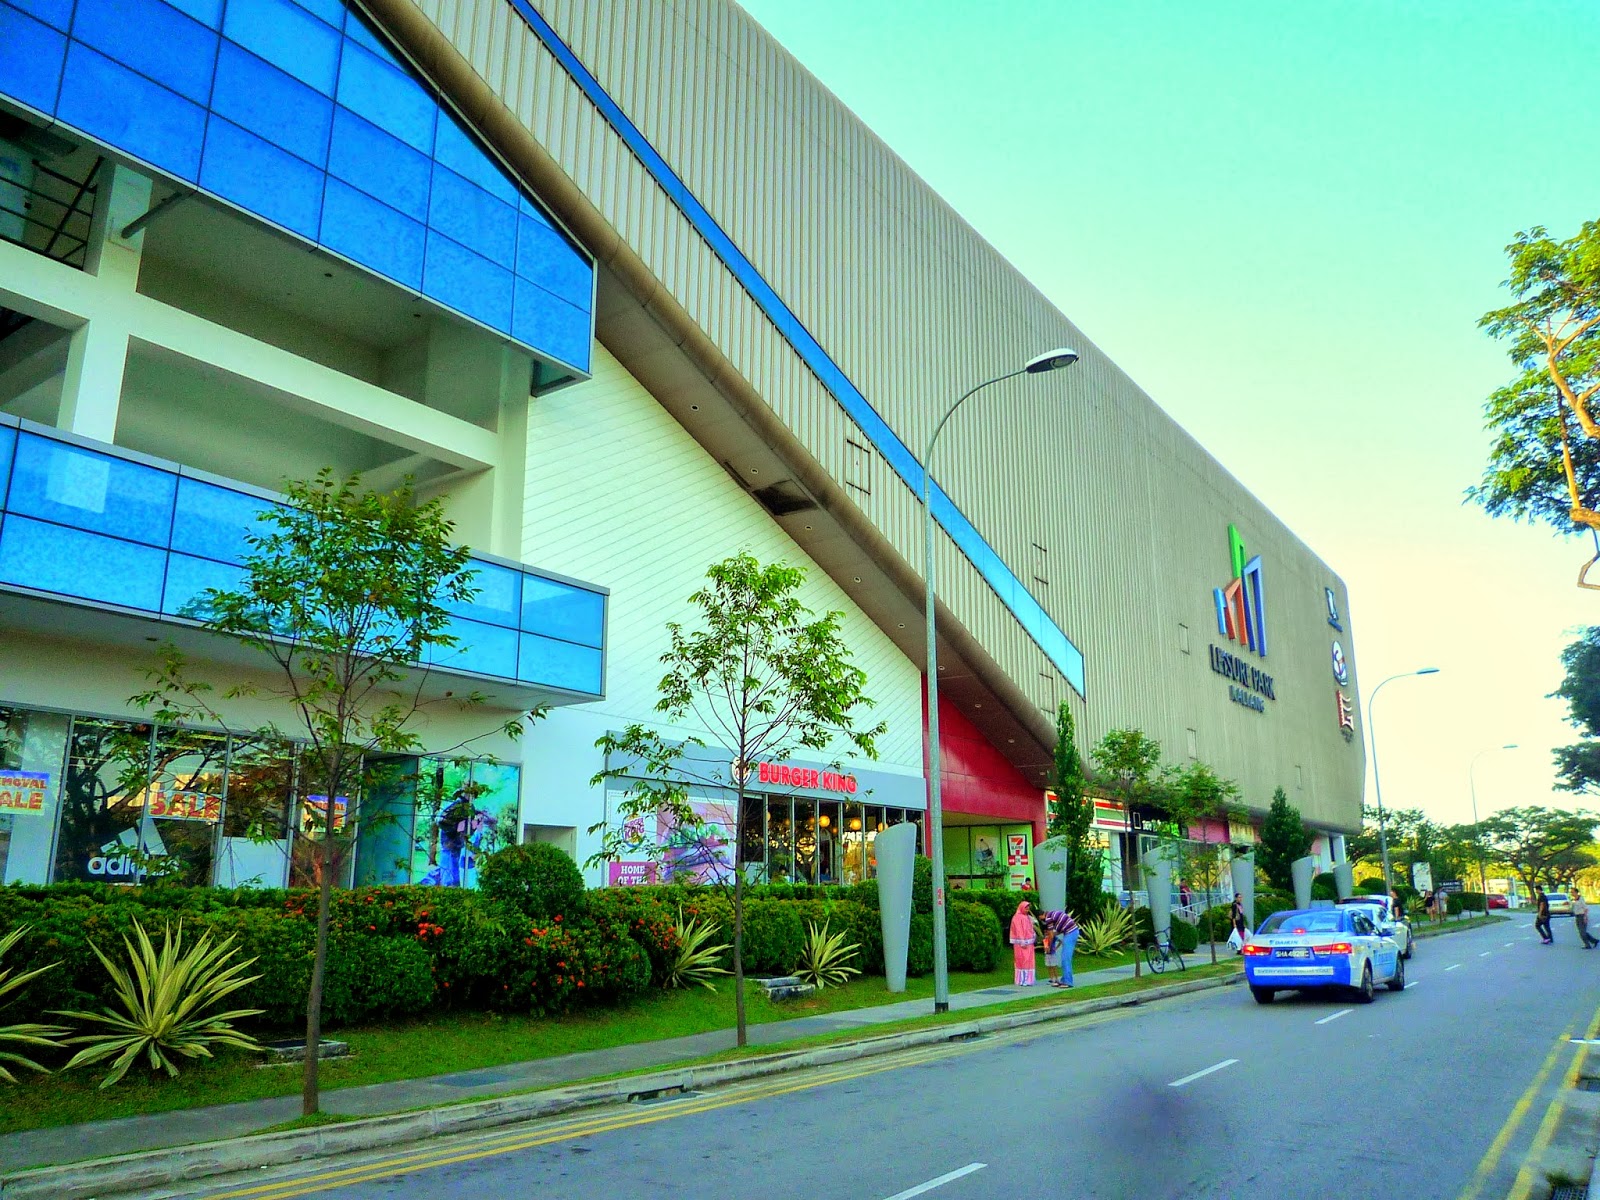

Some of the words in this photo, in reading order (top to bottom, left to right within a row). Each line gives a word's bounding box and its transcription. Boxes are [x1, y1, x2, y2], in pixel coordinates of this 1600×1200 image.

[1251, 666, 1276, 701] PARK
[0, 777, 48, 789] MOVAL
[759, 761, 819, 789] BURGER
[822, 770, 857, 794] KING
[0, 790, 44, 810] ALE
[150, 791, 221, 818] SALE
[621, 865, 646, 875] HOME
[617, 876, 630, 885] OF
